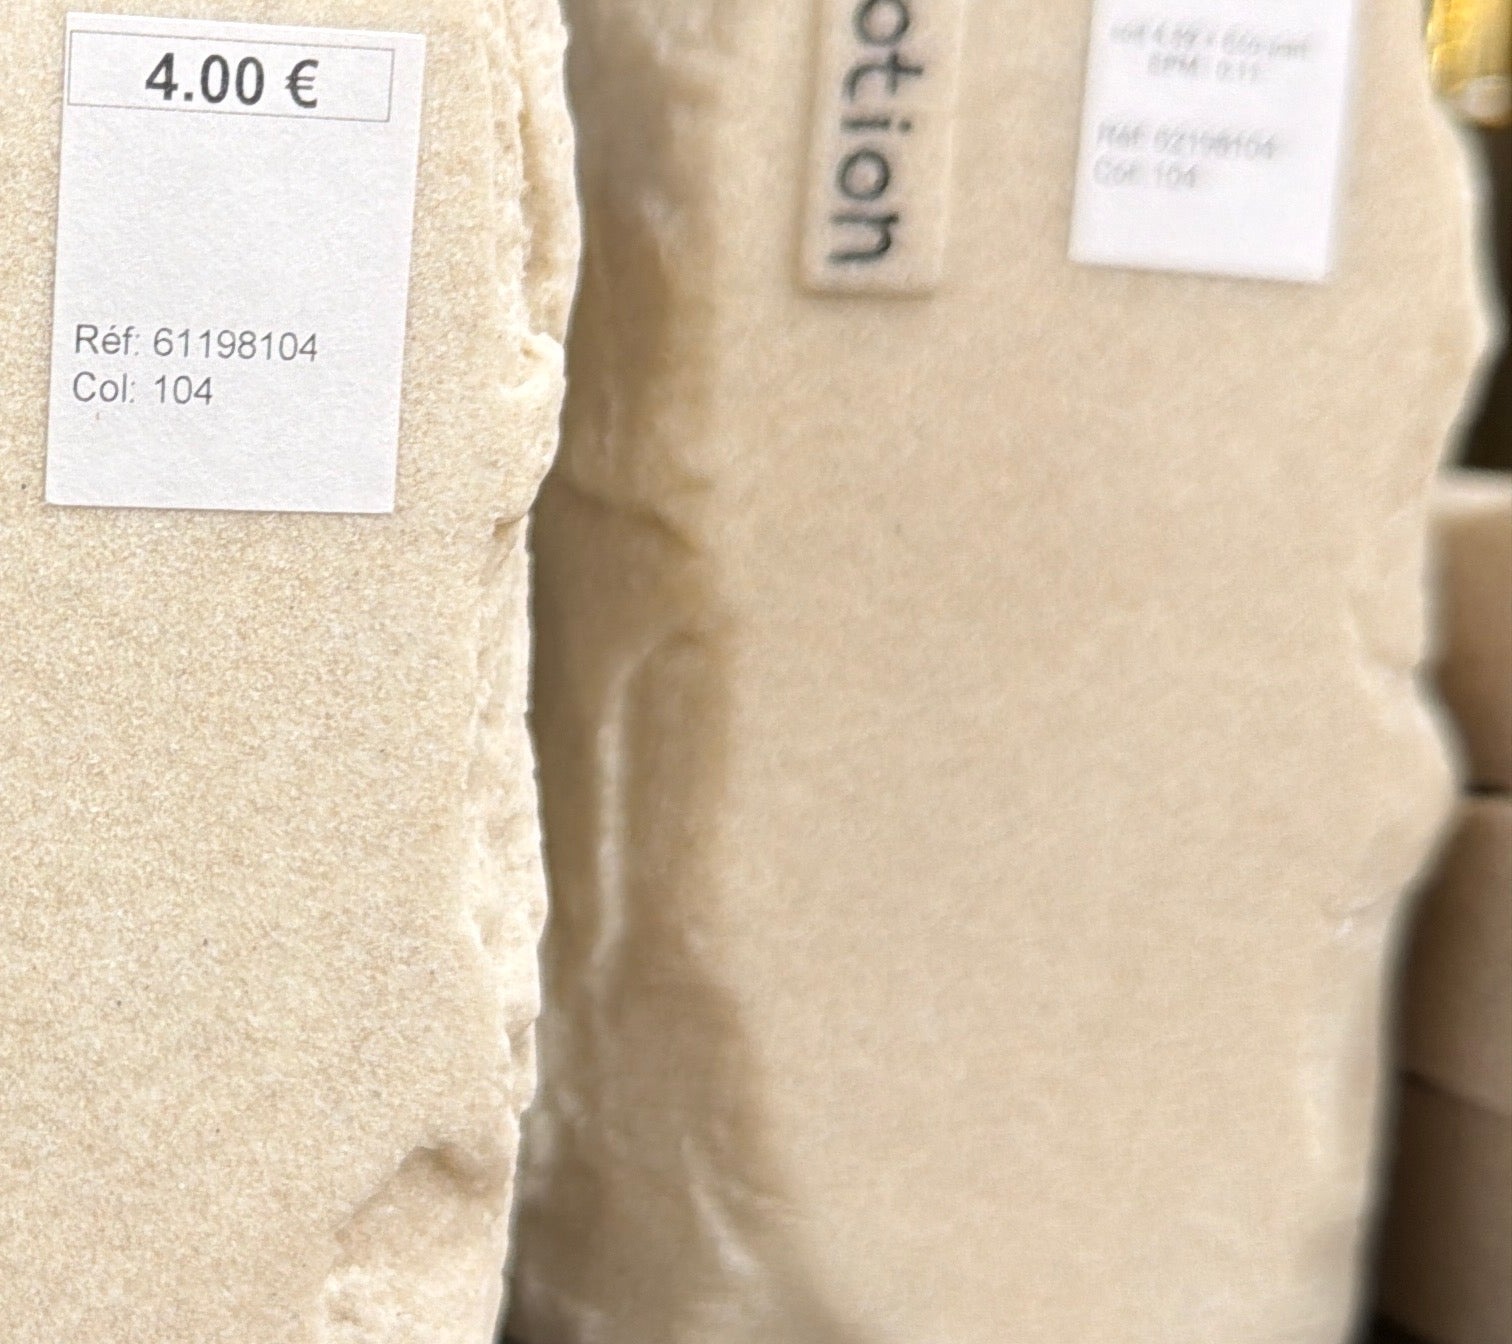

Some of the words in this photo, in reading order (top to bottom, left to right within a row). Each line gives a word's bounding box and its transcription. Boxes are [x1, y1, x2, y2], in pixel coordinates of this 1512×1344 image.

[144, 52, 265, 105] 4.00
[285, 58, 319, 109] €
[75, 324, 140, 356] Réf:
[153, 327, 318, 362] 61198104
[72, 371, 136, 403] Col:
[154, 374, 213, 405] 104
